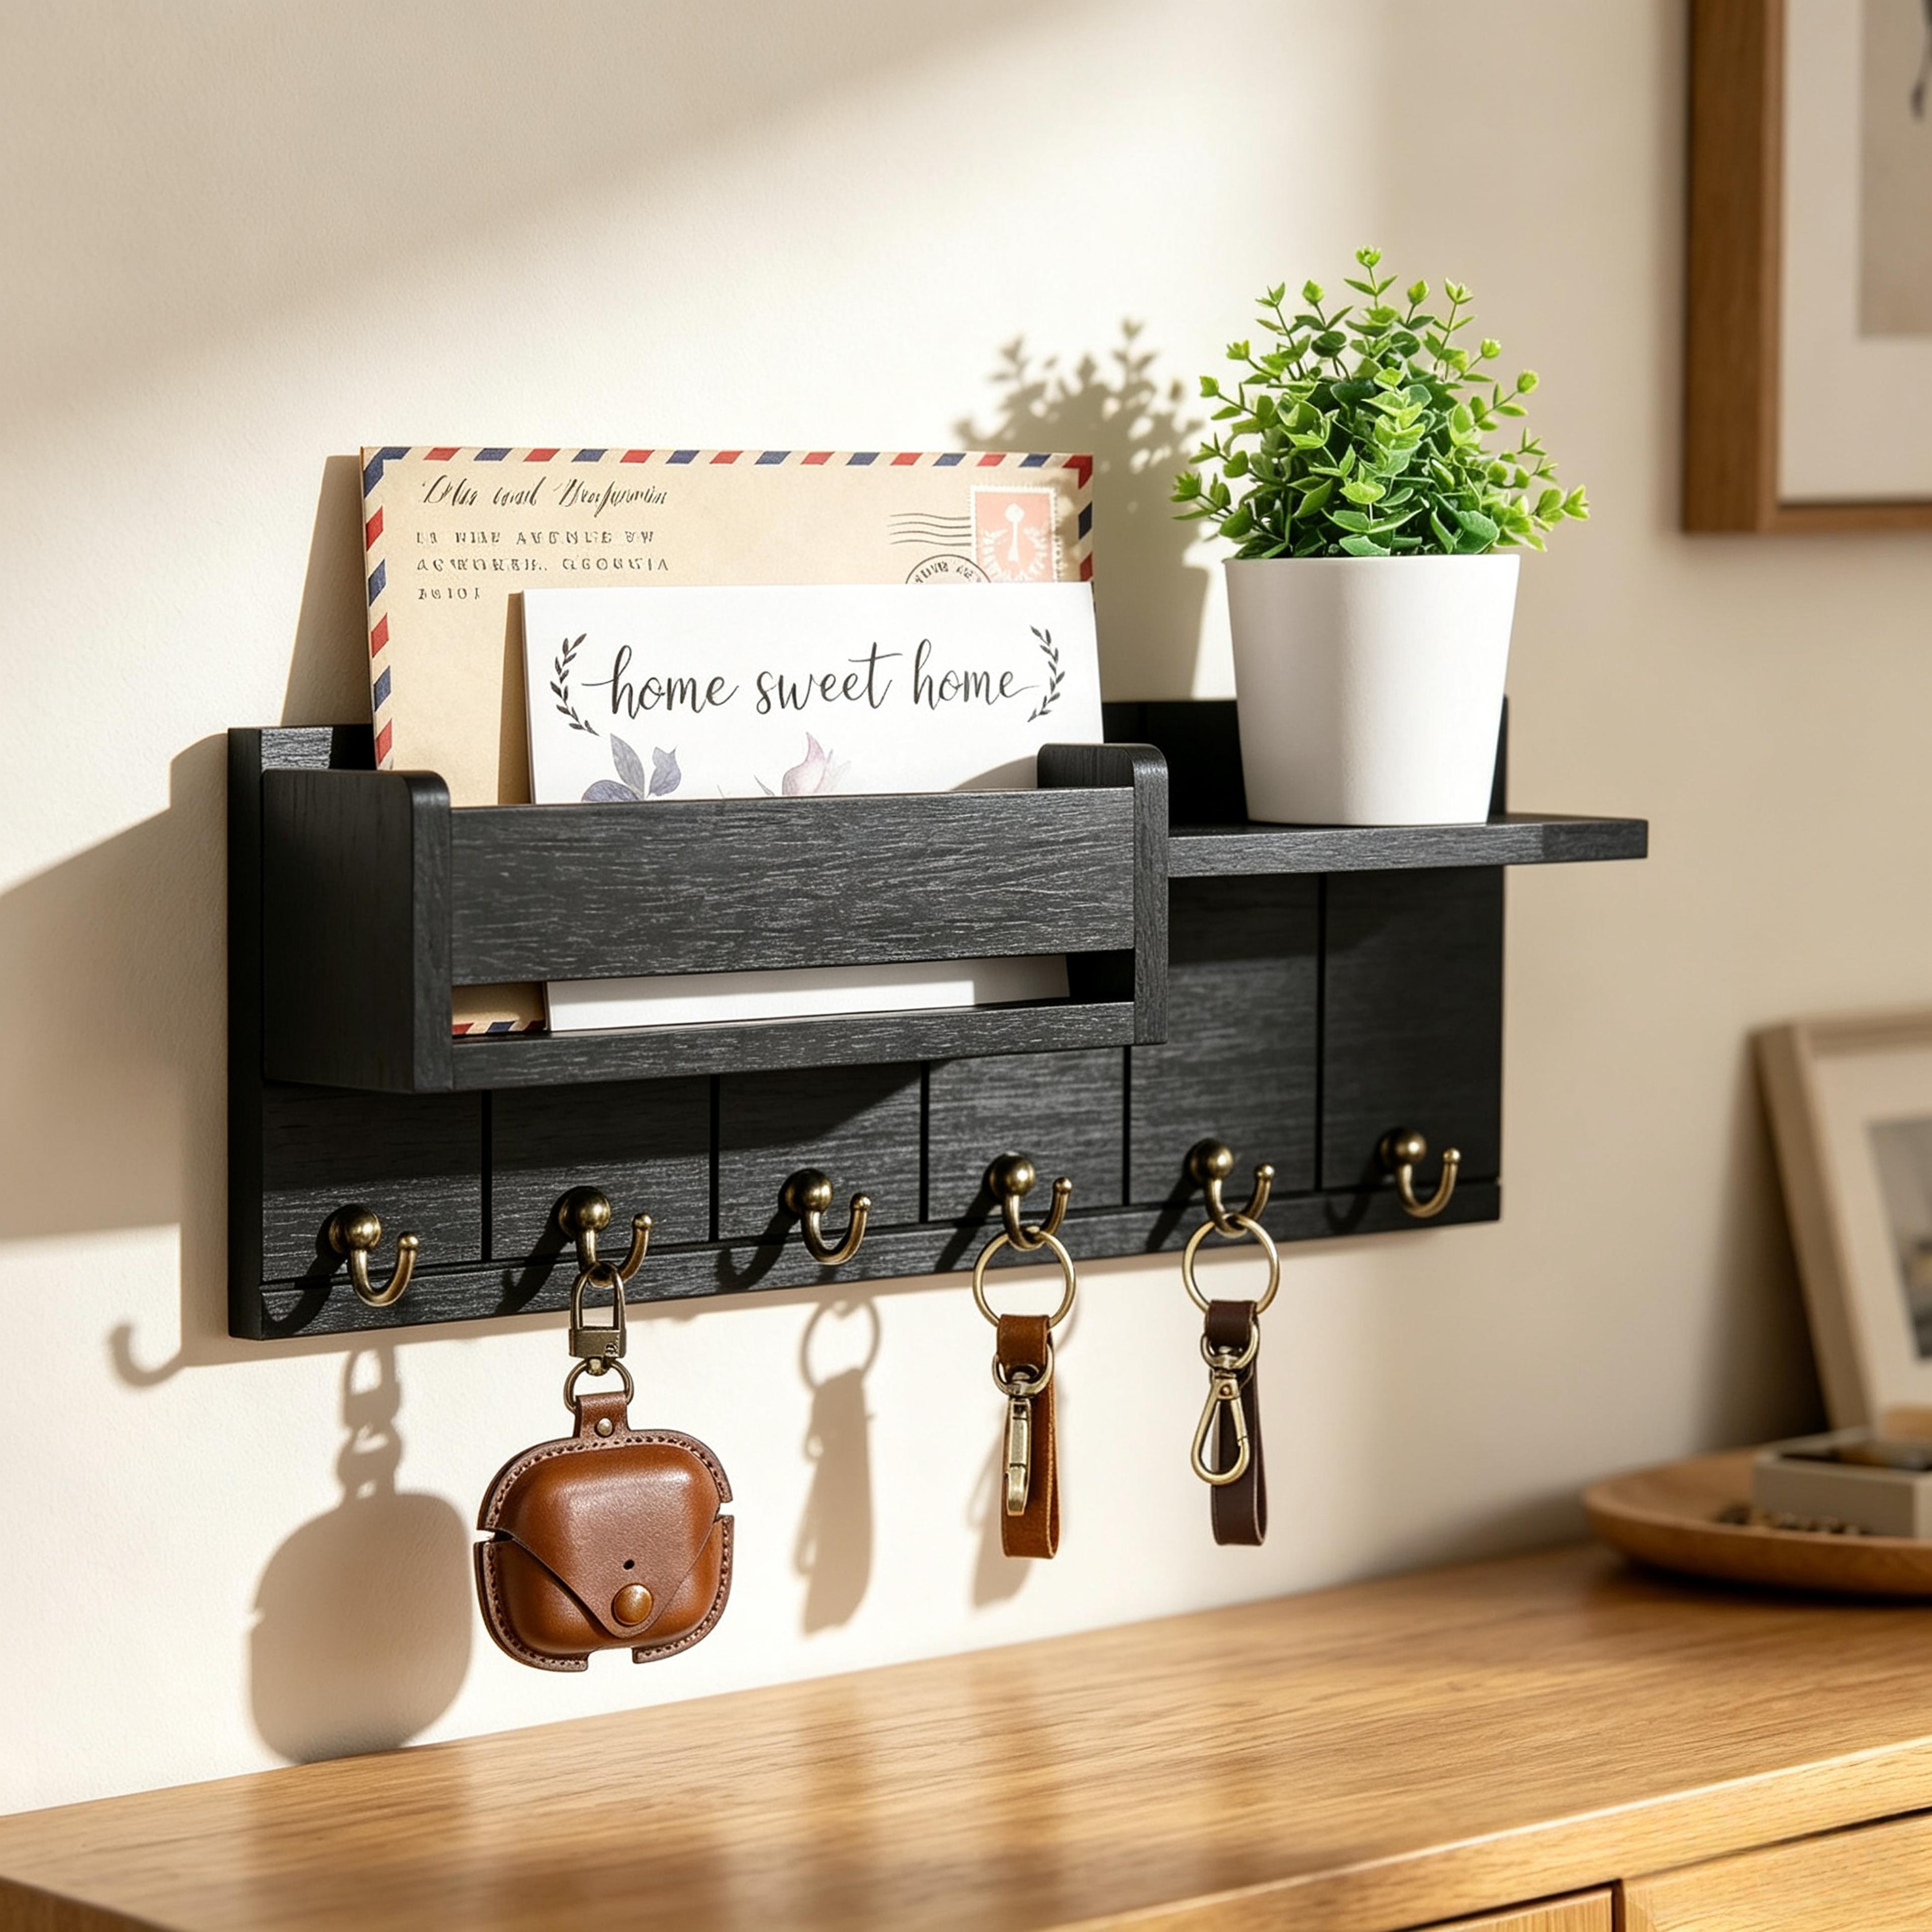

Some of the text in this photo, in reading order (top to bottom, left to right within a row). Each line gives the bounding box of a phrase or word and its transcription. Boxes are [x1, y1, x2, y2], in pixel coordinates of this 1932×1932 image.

[582, 638, 1039, 720] home sweet home
